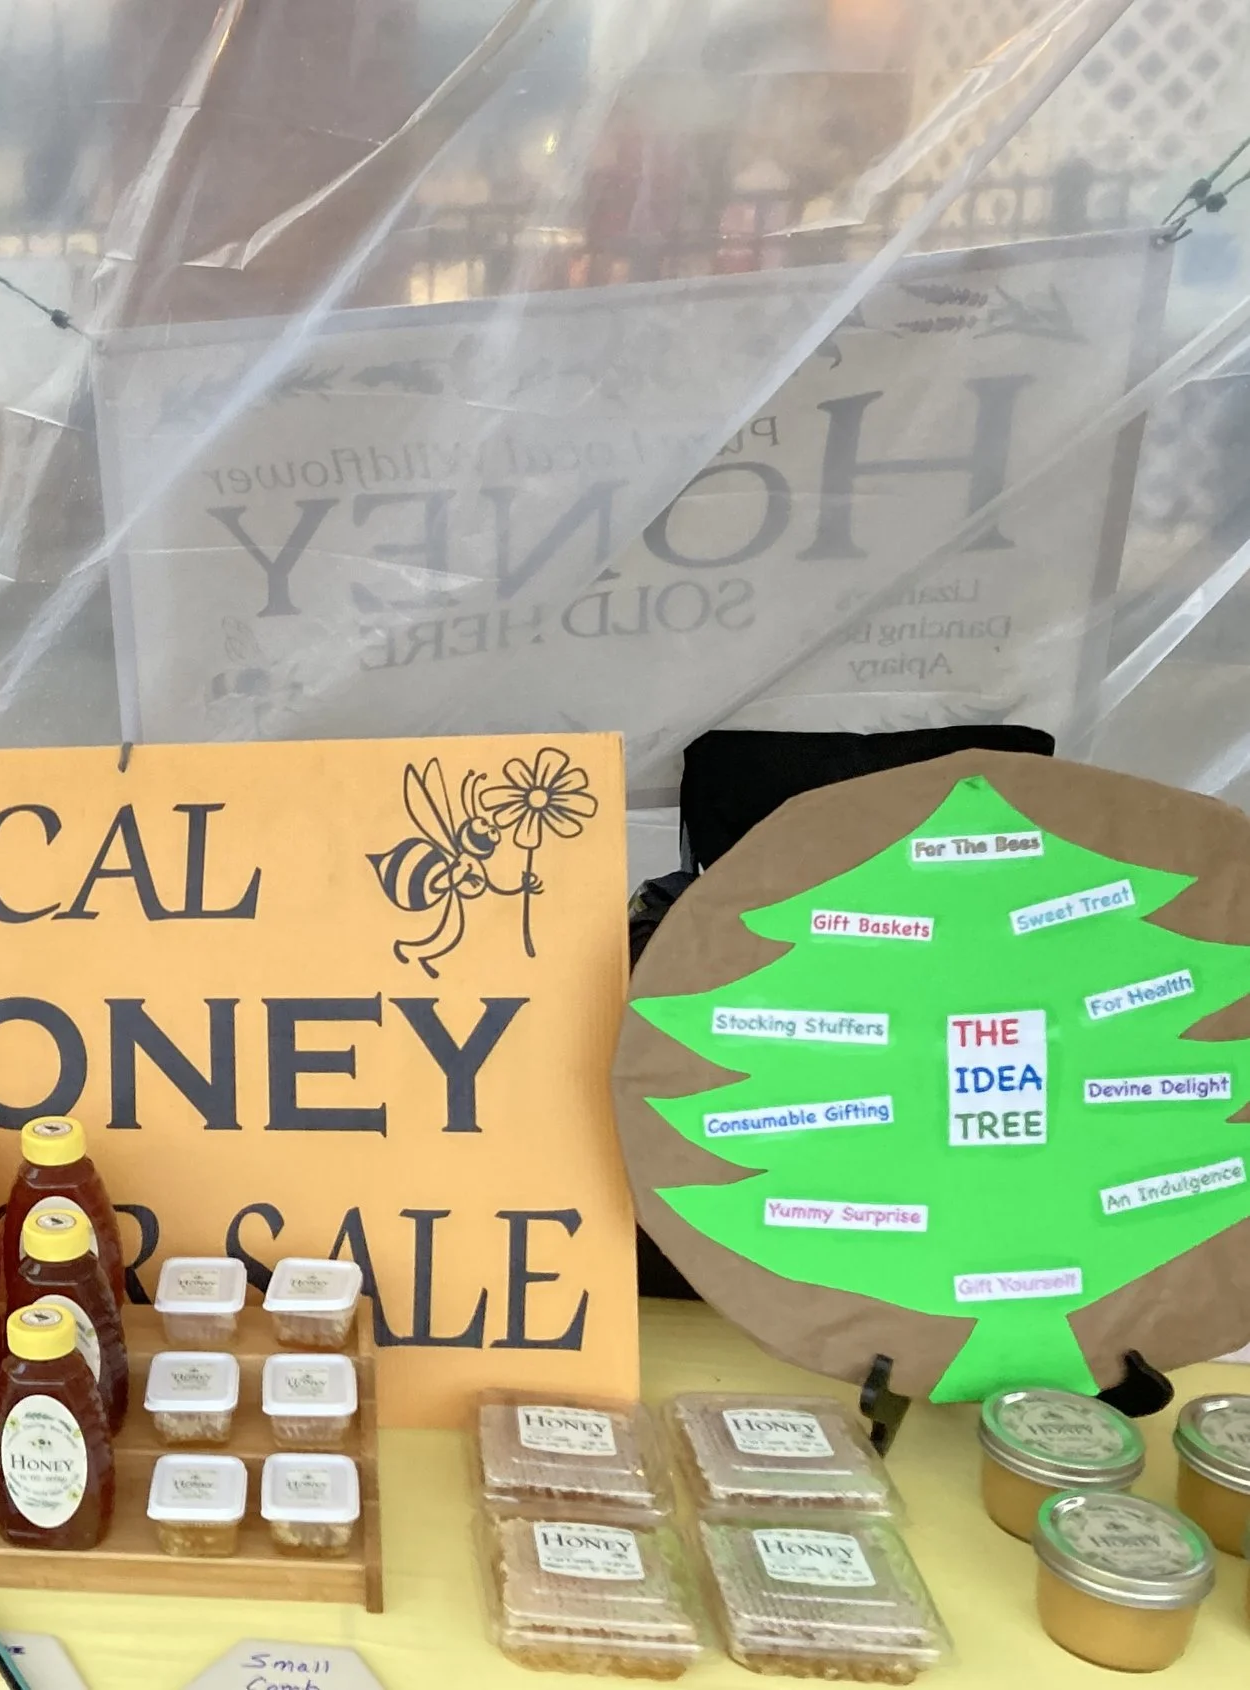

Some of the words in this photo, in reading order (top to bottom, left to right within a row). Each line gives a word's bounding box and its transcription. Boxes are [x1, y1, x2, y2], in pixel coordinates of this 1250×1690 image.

[915, 840, 947, 860] For
[951, 837, 989, 856] The
[995, 834, 1041, 853] Bees
[1016, 904, 1077, 932] Sweet
[1080, 886, 1132, 917] Treat
[813, 914, 850, 934] Gift
[859, 917, 931, 939] Baskets
[1090, 994, 1124, 1017] For
[1127, 974, 1194, 1006] Health
[715, 1013, 798, 1037] Stocking
[803, 1015, 885, 1037] Stuffers
[953, 1018, 1020, 1047] THE
[954, 1065, 1043, 1095] IDEA
[1087, 1079, 1154, 1099] Devine
[1160, 1076, 1230, 1100] Delight
[707, 1107, 818, 1136] Consumable
[824, 1100, 890, 1126] Gifting
[954, 1110, 1044, 1139] TREE
[1105, 1192, 1133, 1211] An
[1137, 1163, 1244, 1202] Indulgence
[767, 1201, 834, 1224] Yummy
[841, 1205, 922, 1227] Surprise
[224, 1202, 588, 1350] SALE
[958, 1277, 994, 1297] Gift
[998, 1271, 1077, 1293] Yourself
[524, 1413, 607, 1433] HONEY
[731, 1418, 816, 1434] HONEY
[11, 1453, 73, 1472] HONEY
[542, 1531, 633, 1552] HONEY
[760, 1539, 854, 1559] HONEY
[241, 1653, 330, 1673] Small
